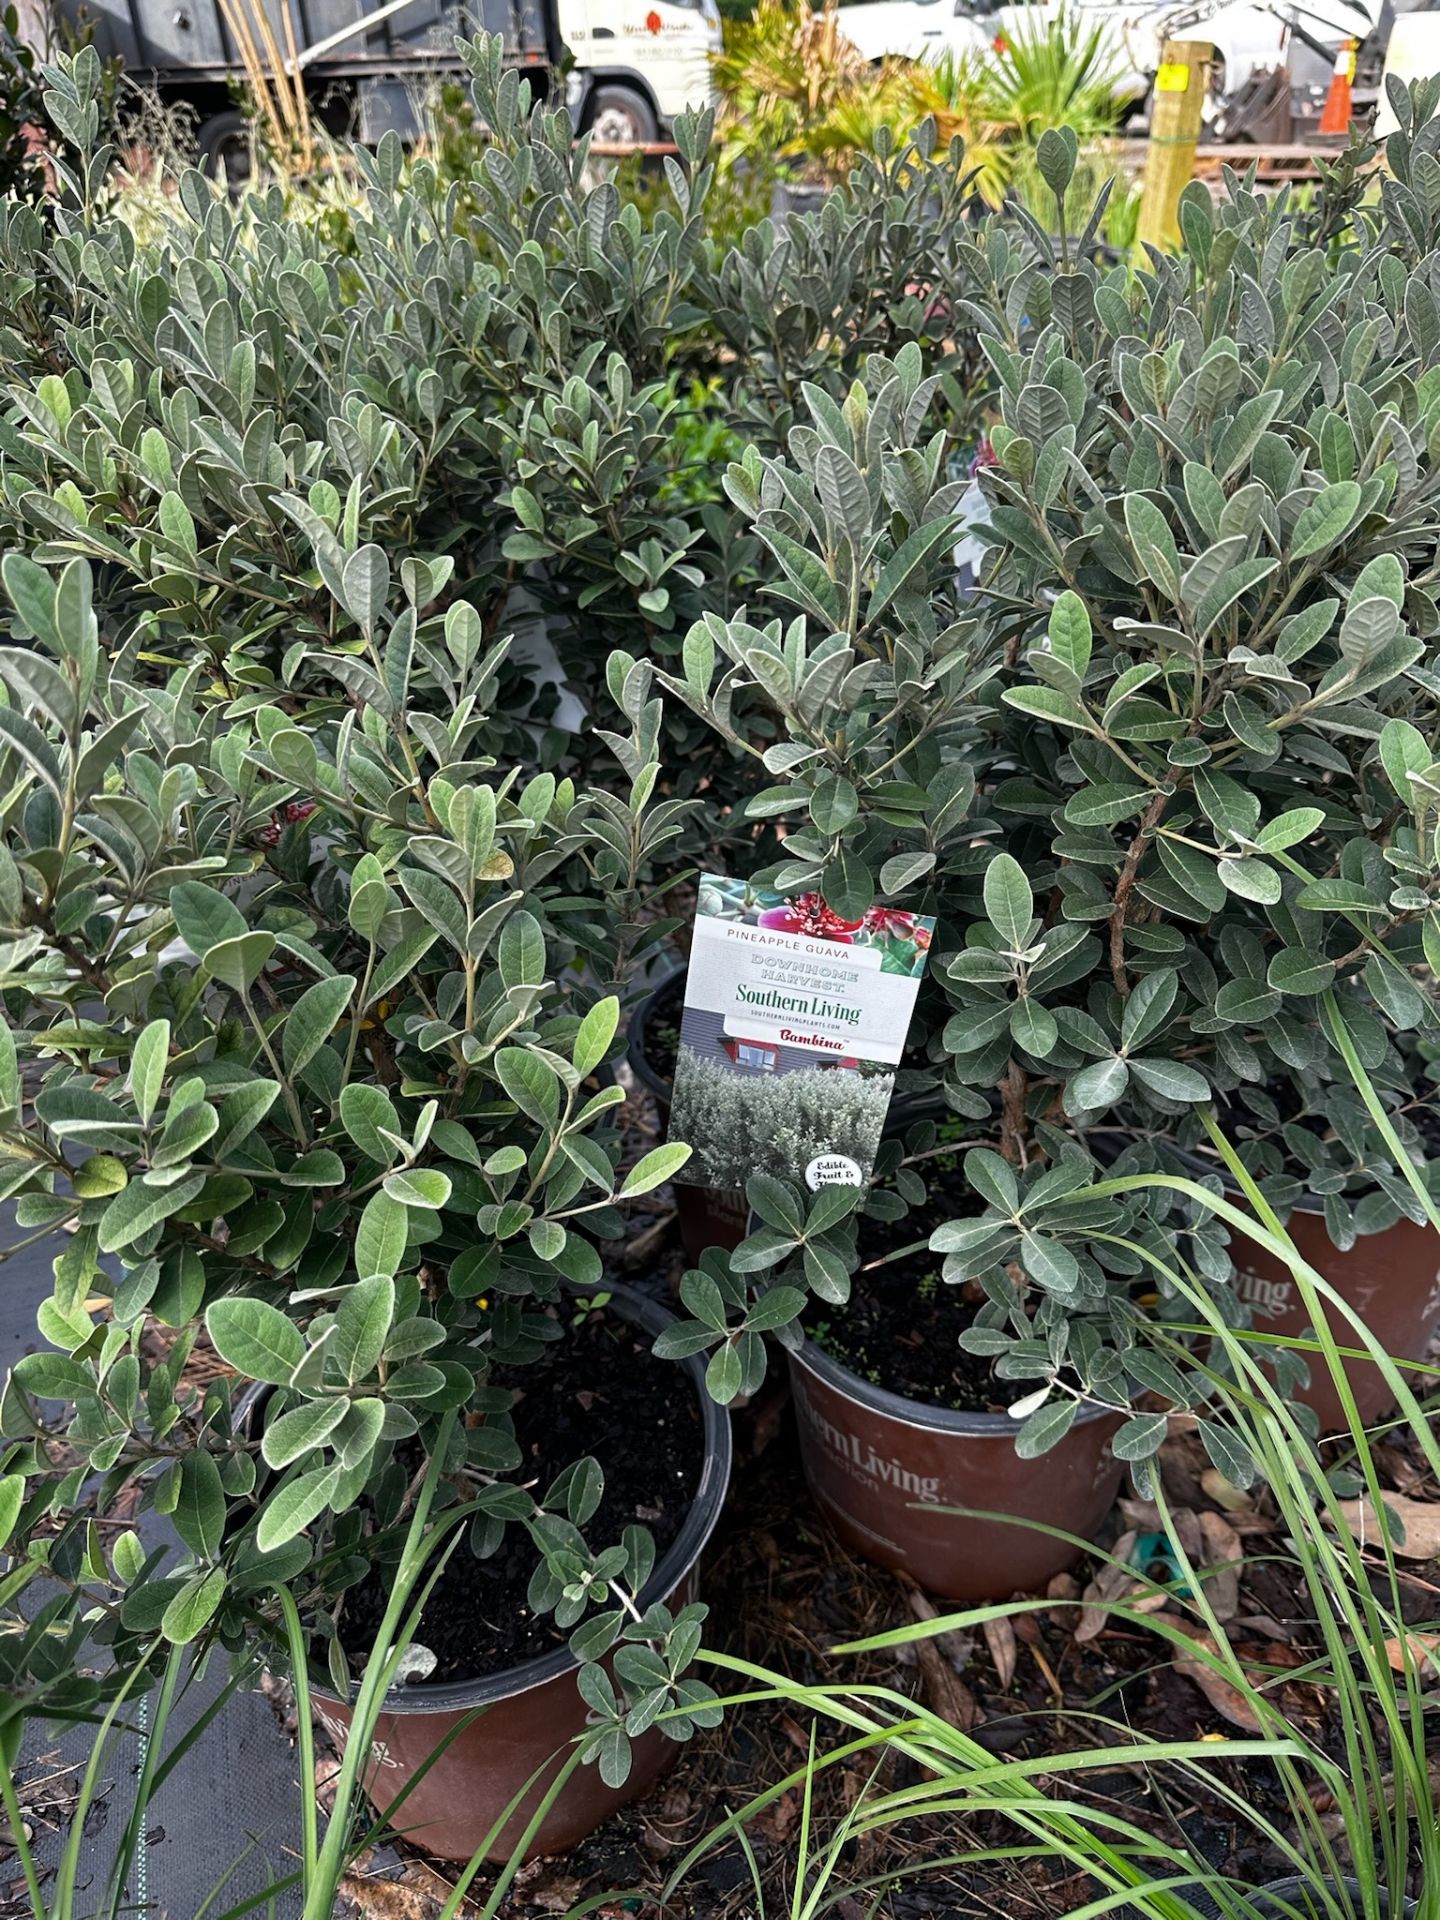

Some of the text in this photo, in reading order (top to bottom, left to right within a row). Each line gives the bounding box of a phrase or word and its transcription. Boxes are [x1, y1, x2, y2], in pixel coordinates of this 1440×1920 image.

[728, 928, 849, 960] PINEAPPLE GUAVA
[751, 953, 860, 983] DOWNHOME
[736, 983, 862, 1026] Southern Living
[779, 1029, 845, 1051] Bambina
[813, 1171, 843, 1180] Fruit
[817, 1160, 849, 1171] Edible
